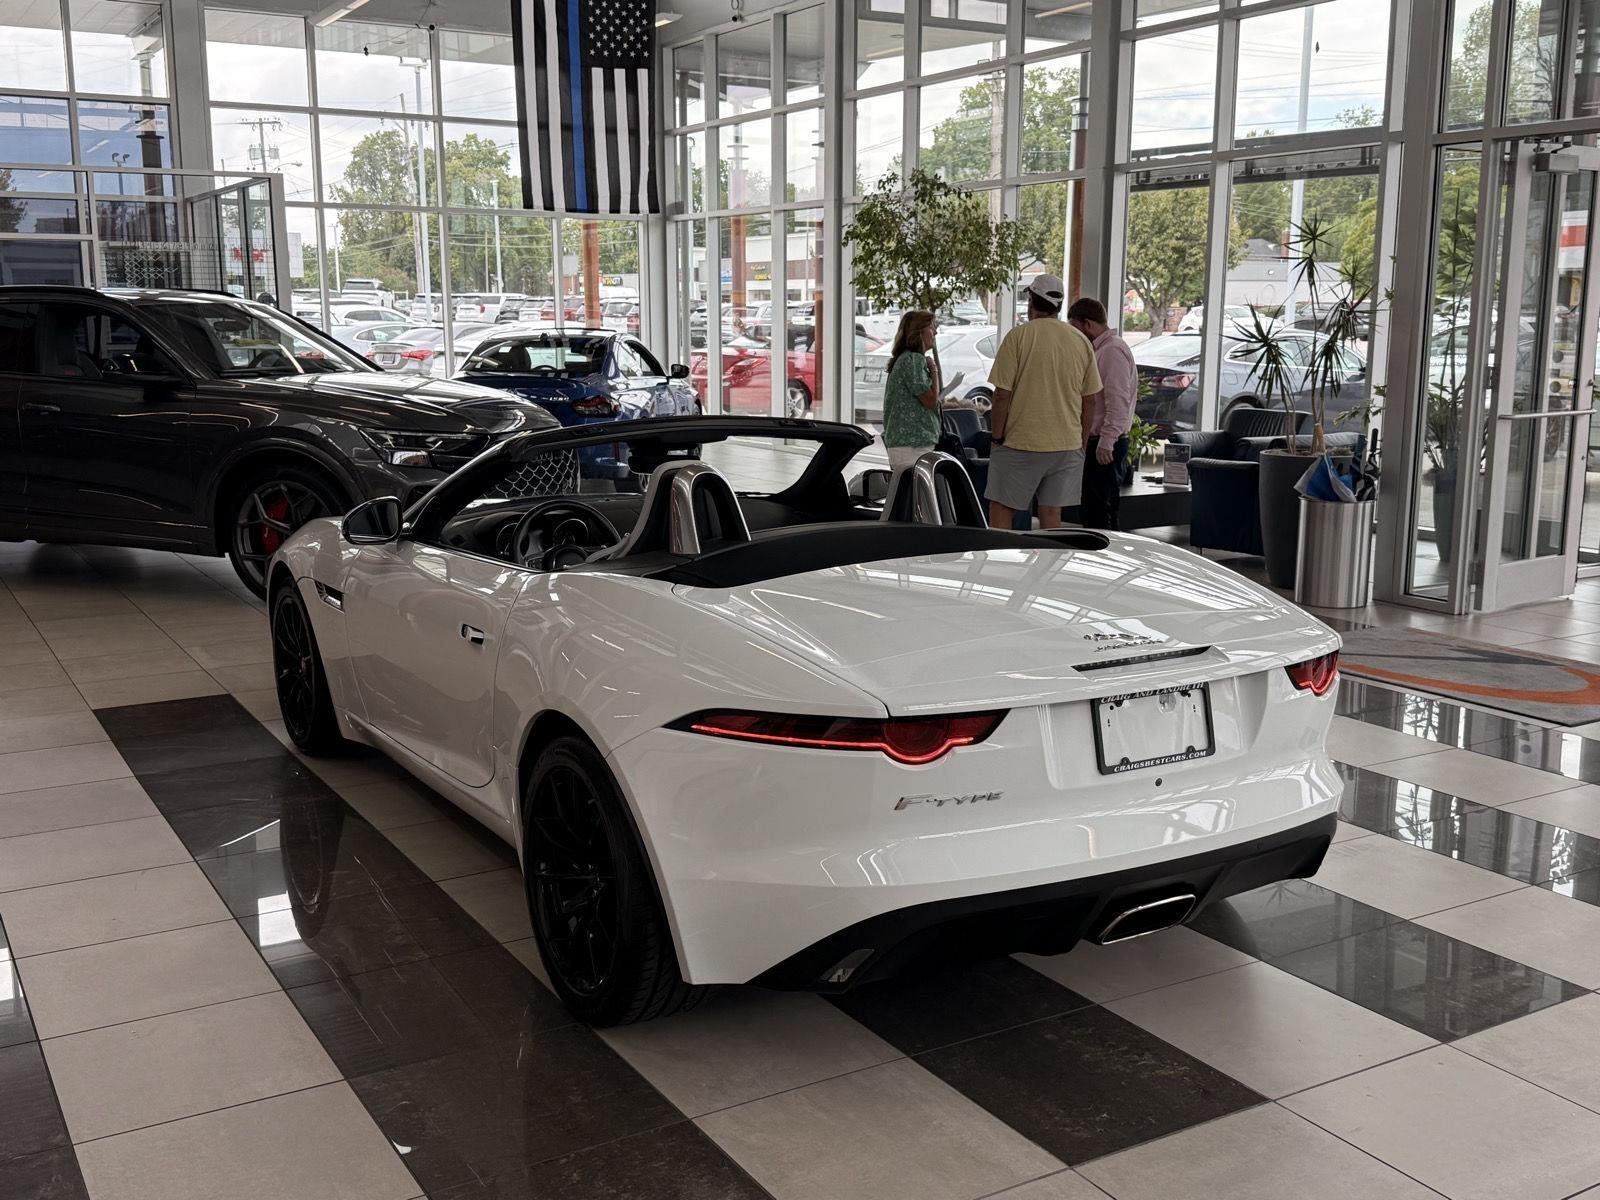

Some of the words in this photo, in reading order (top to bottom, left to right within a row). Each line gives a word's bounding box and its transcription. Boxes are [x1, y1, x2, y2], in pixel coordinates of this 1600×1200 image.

[1101, 693, 1131, 704] CRAIG
[1134, 690, 1153, 698] AND
[1113, 750, 1207, 773] CRAIGSBESTCARS.COM
[893, 790, 1005, 811] F-TYPE
